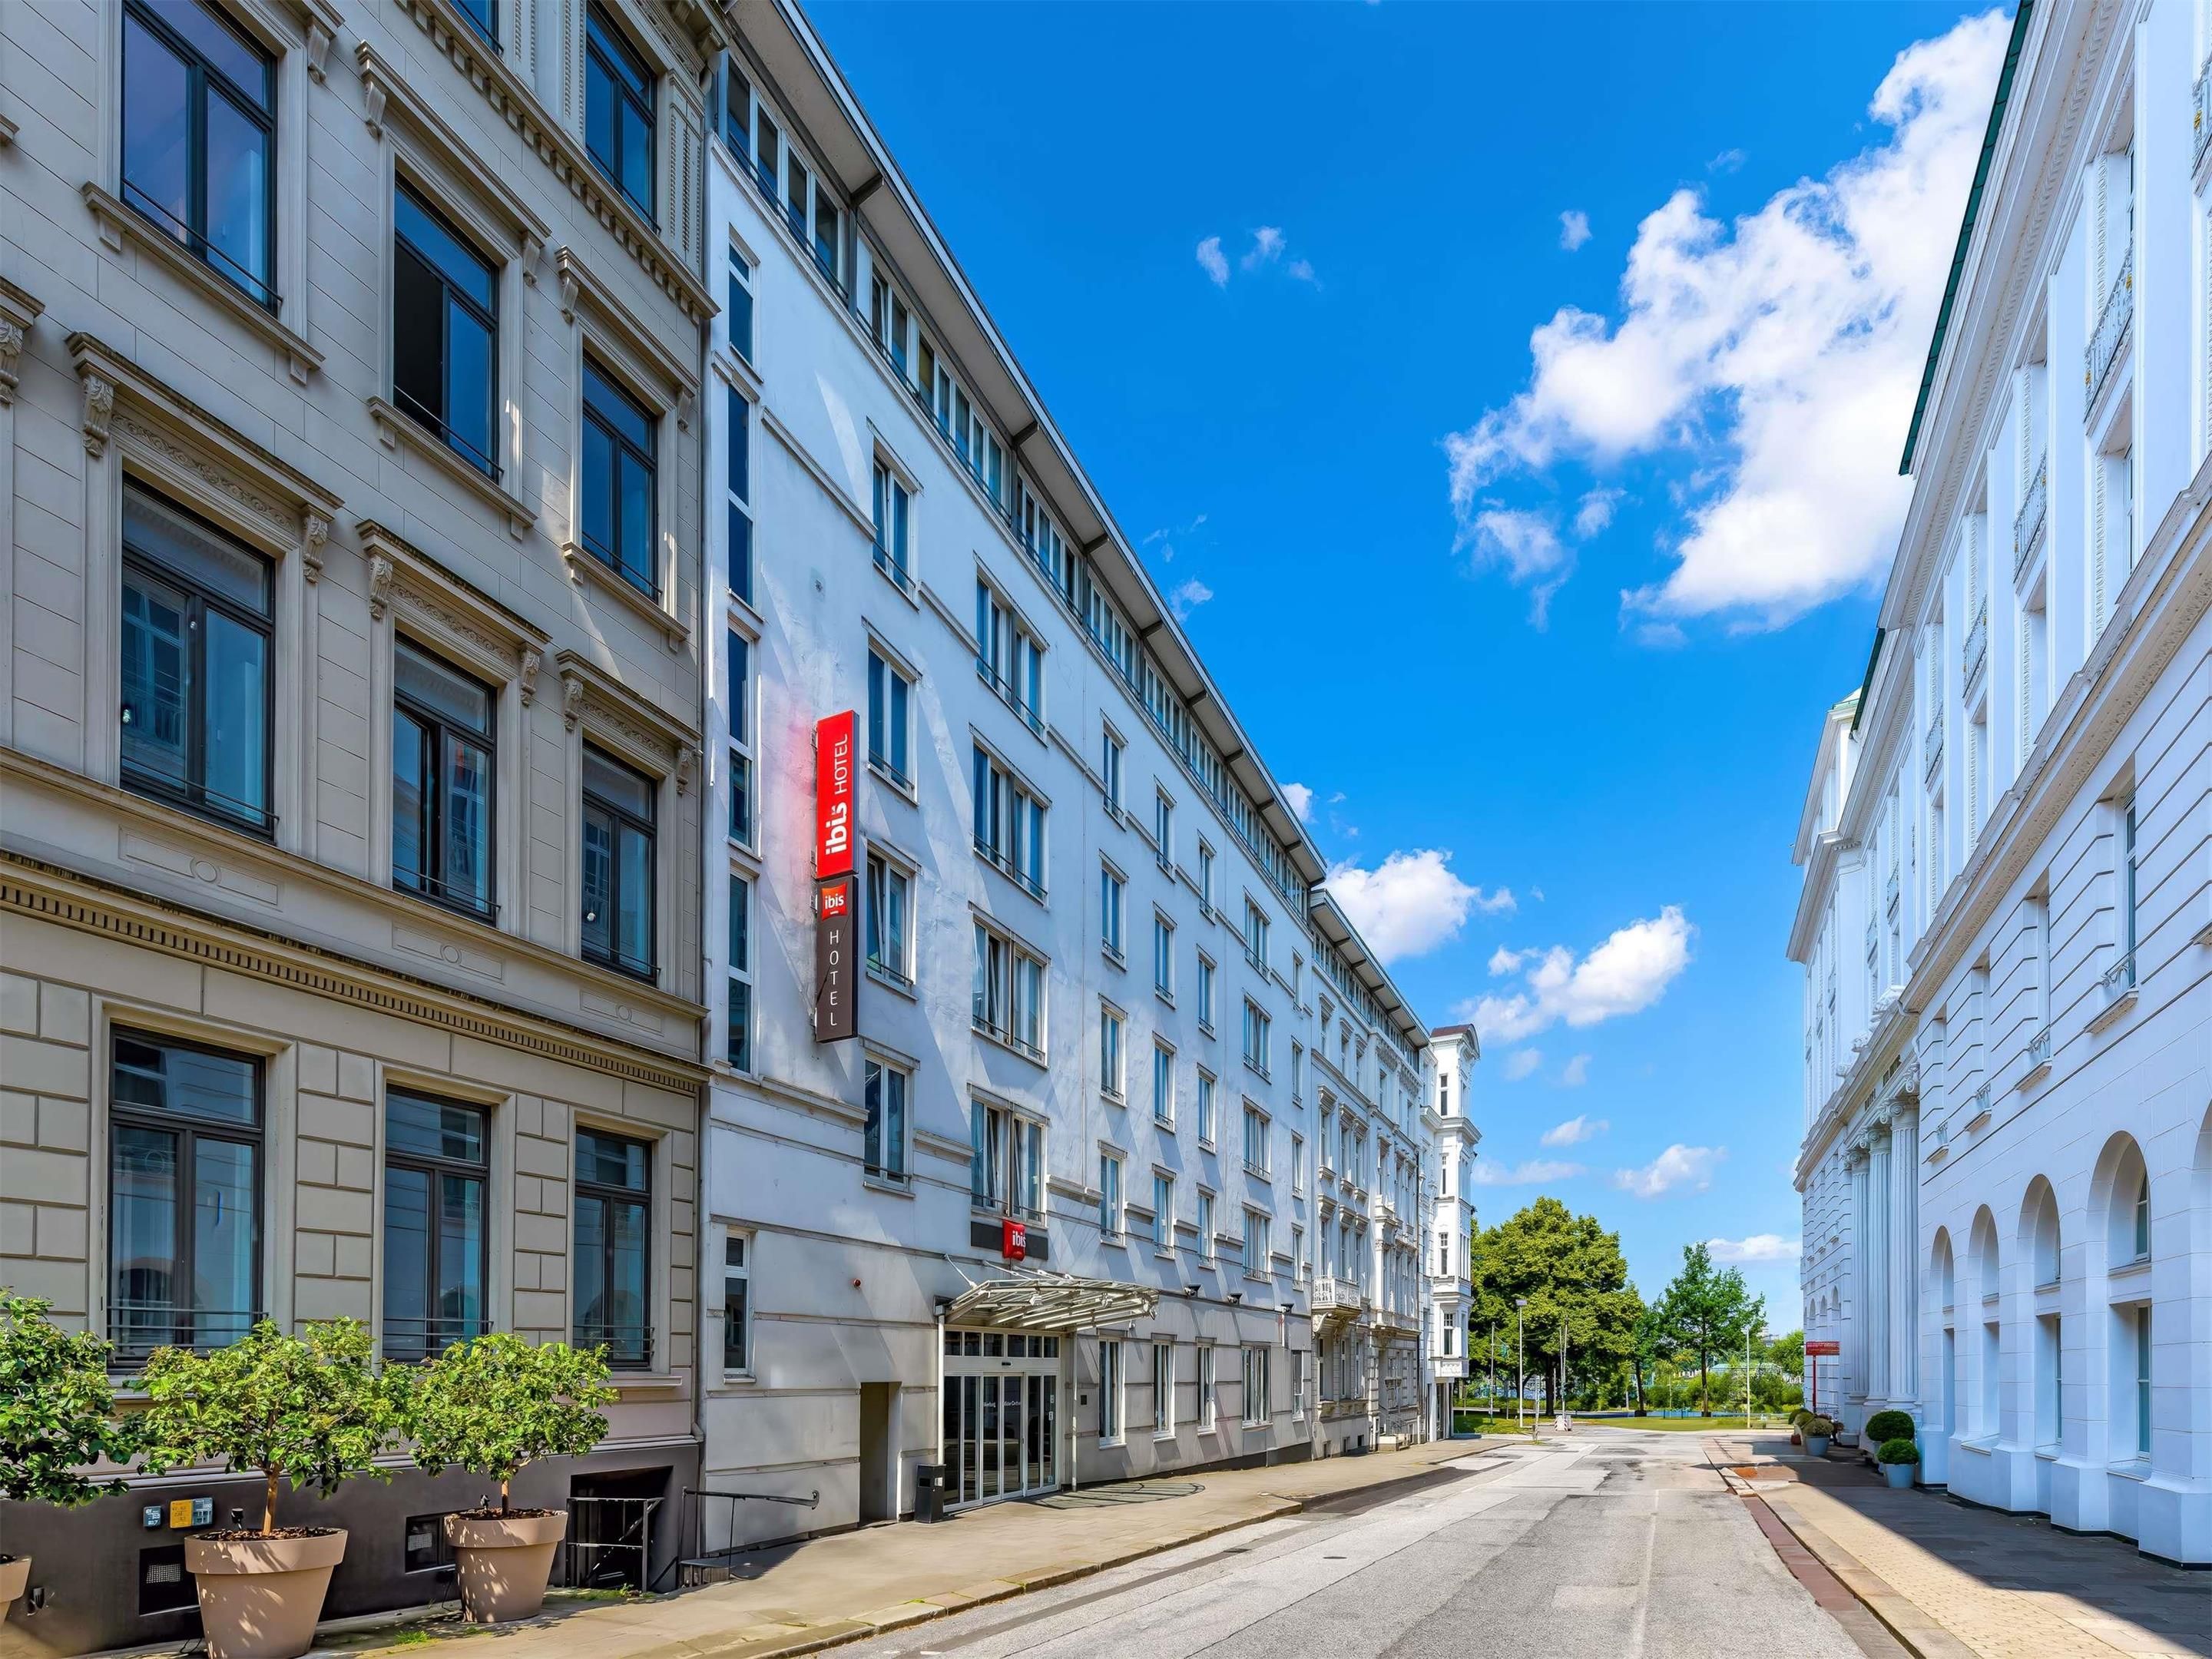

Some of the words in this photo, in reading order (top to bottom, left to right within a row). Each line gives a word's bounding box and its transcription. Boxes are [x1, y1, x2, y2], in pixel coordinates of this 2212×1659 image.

[835, 733, 848, 794] HOTEL
[826, 802, 847, 854] ibis
[824, 892, 844, 909] ibis
[830, 929, 839, 1026] HOTEL
[1012, 1230, 1026, 1248] ibis
